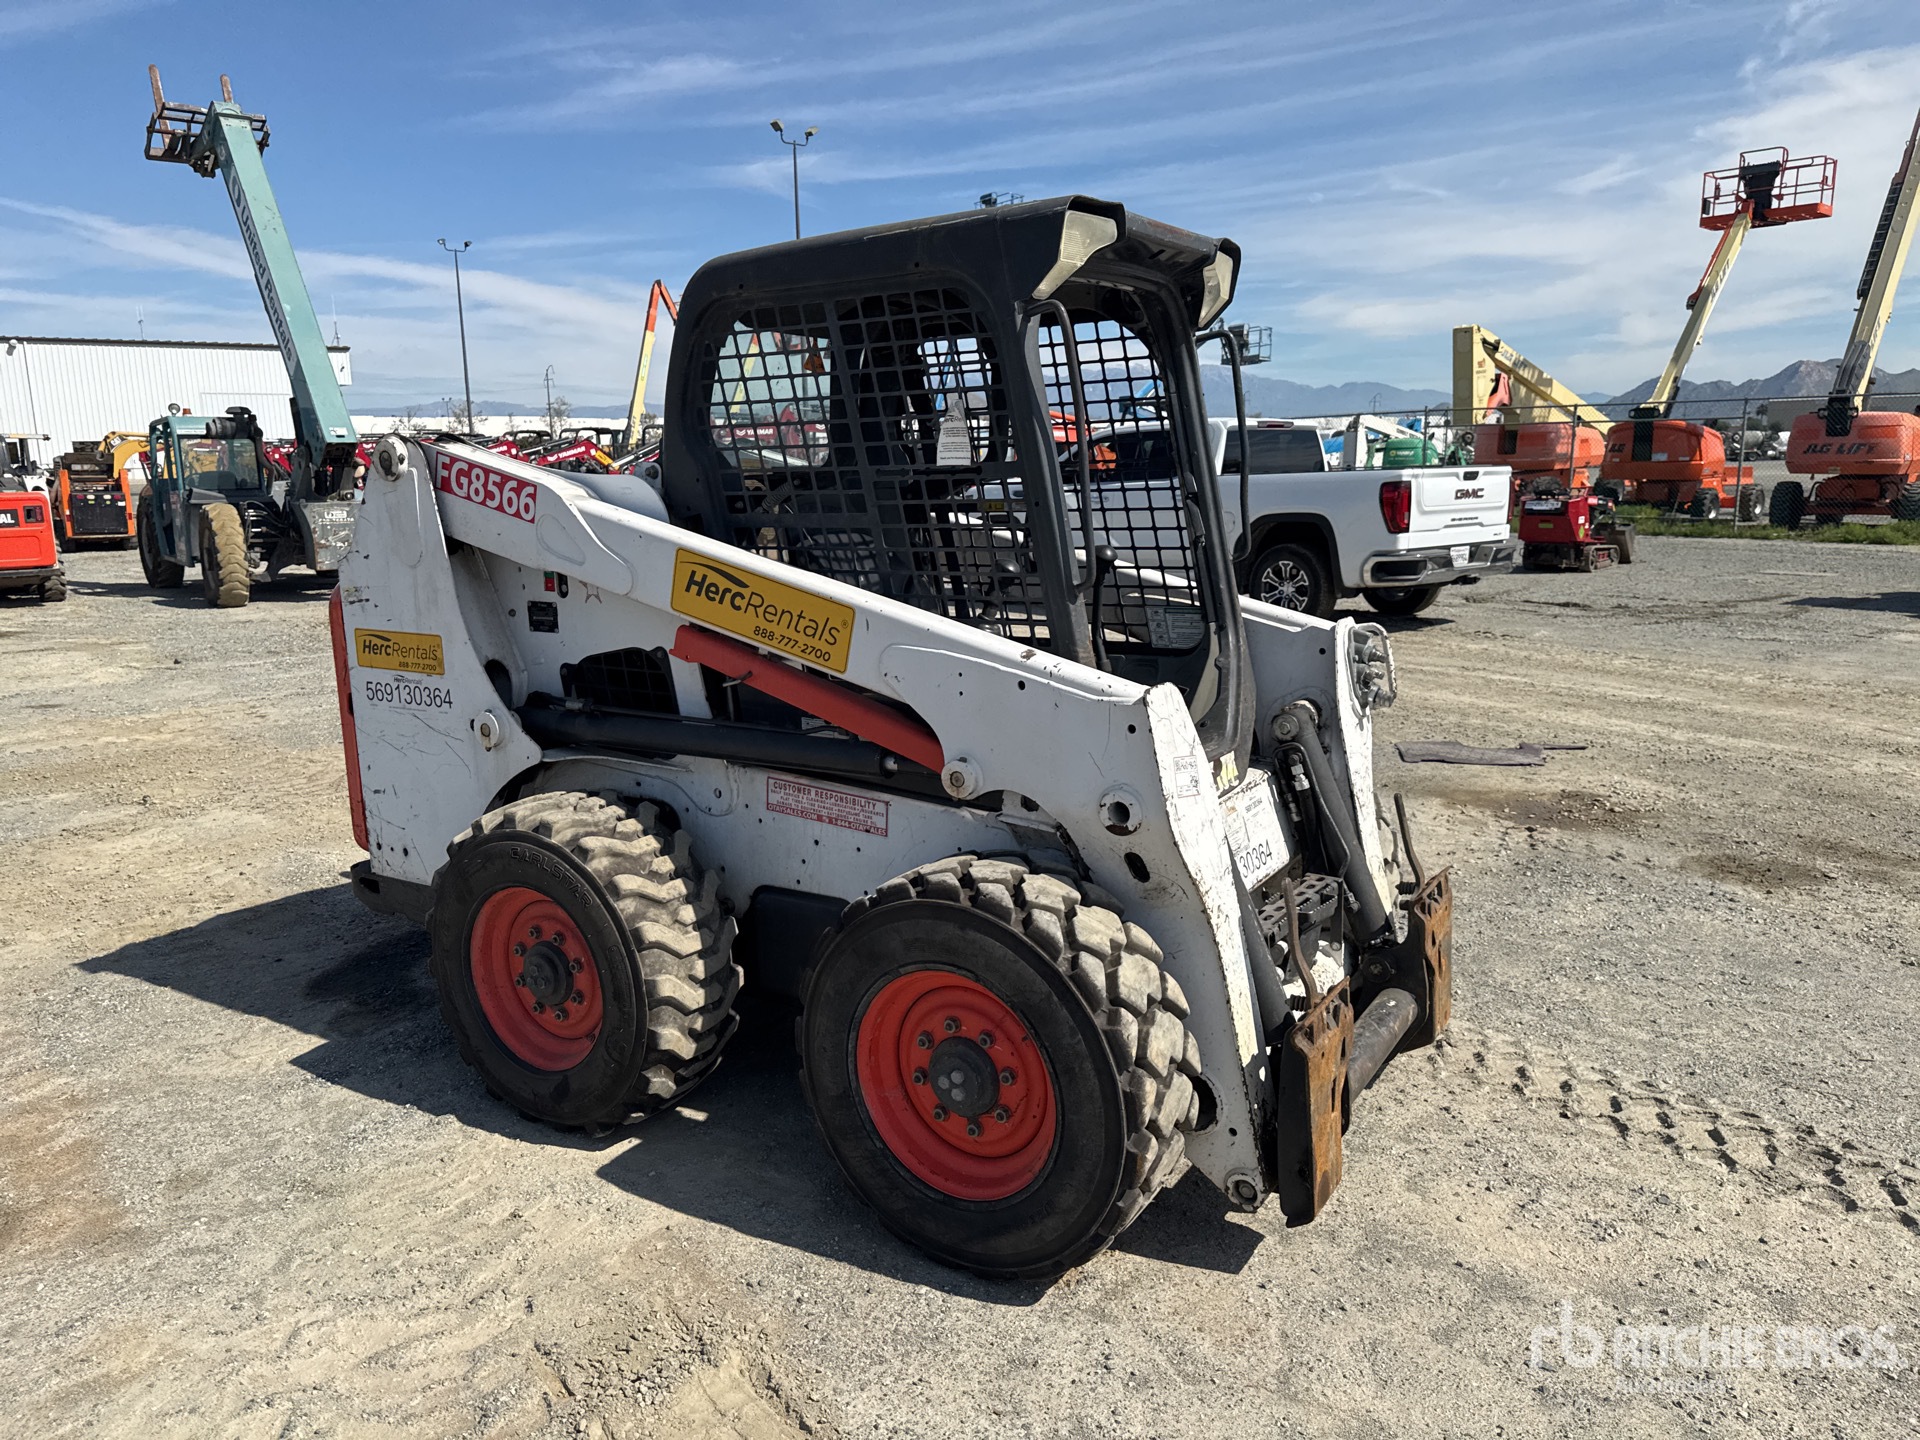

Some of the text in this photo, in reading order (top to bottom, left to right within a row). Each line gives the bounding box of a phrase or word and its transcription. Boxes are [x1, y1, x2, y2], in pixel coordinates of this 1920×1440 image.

[241, 205, 293, 361] United Rentals
[558, 446, 586, 459] YANMAR
[1835, 442, 1879, 455] LIFT
[436, 452, 536, 521] FG8566
[1454, 488, 1485, 500] GMC
[684, 570, 841, 646] HercRentals
[362, 639, 438, 661] HercRentals
[753, 625, 831, 662] 888-777-2700
[398, 661, 437, 672] 888-777-2700
[366, 681, 453, 709] 569130364
[773, 780, 876, 810] CUSTOMER RESPONSIBILITY
[767, 803, 817, 820] OTAYSALES.COM
[1240, 838, 1273, 878] 30364
[509, 846, 593, 907] CARLSTAR
